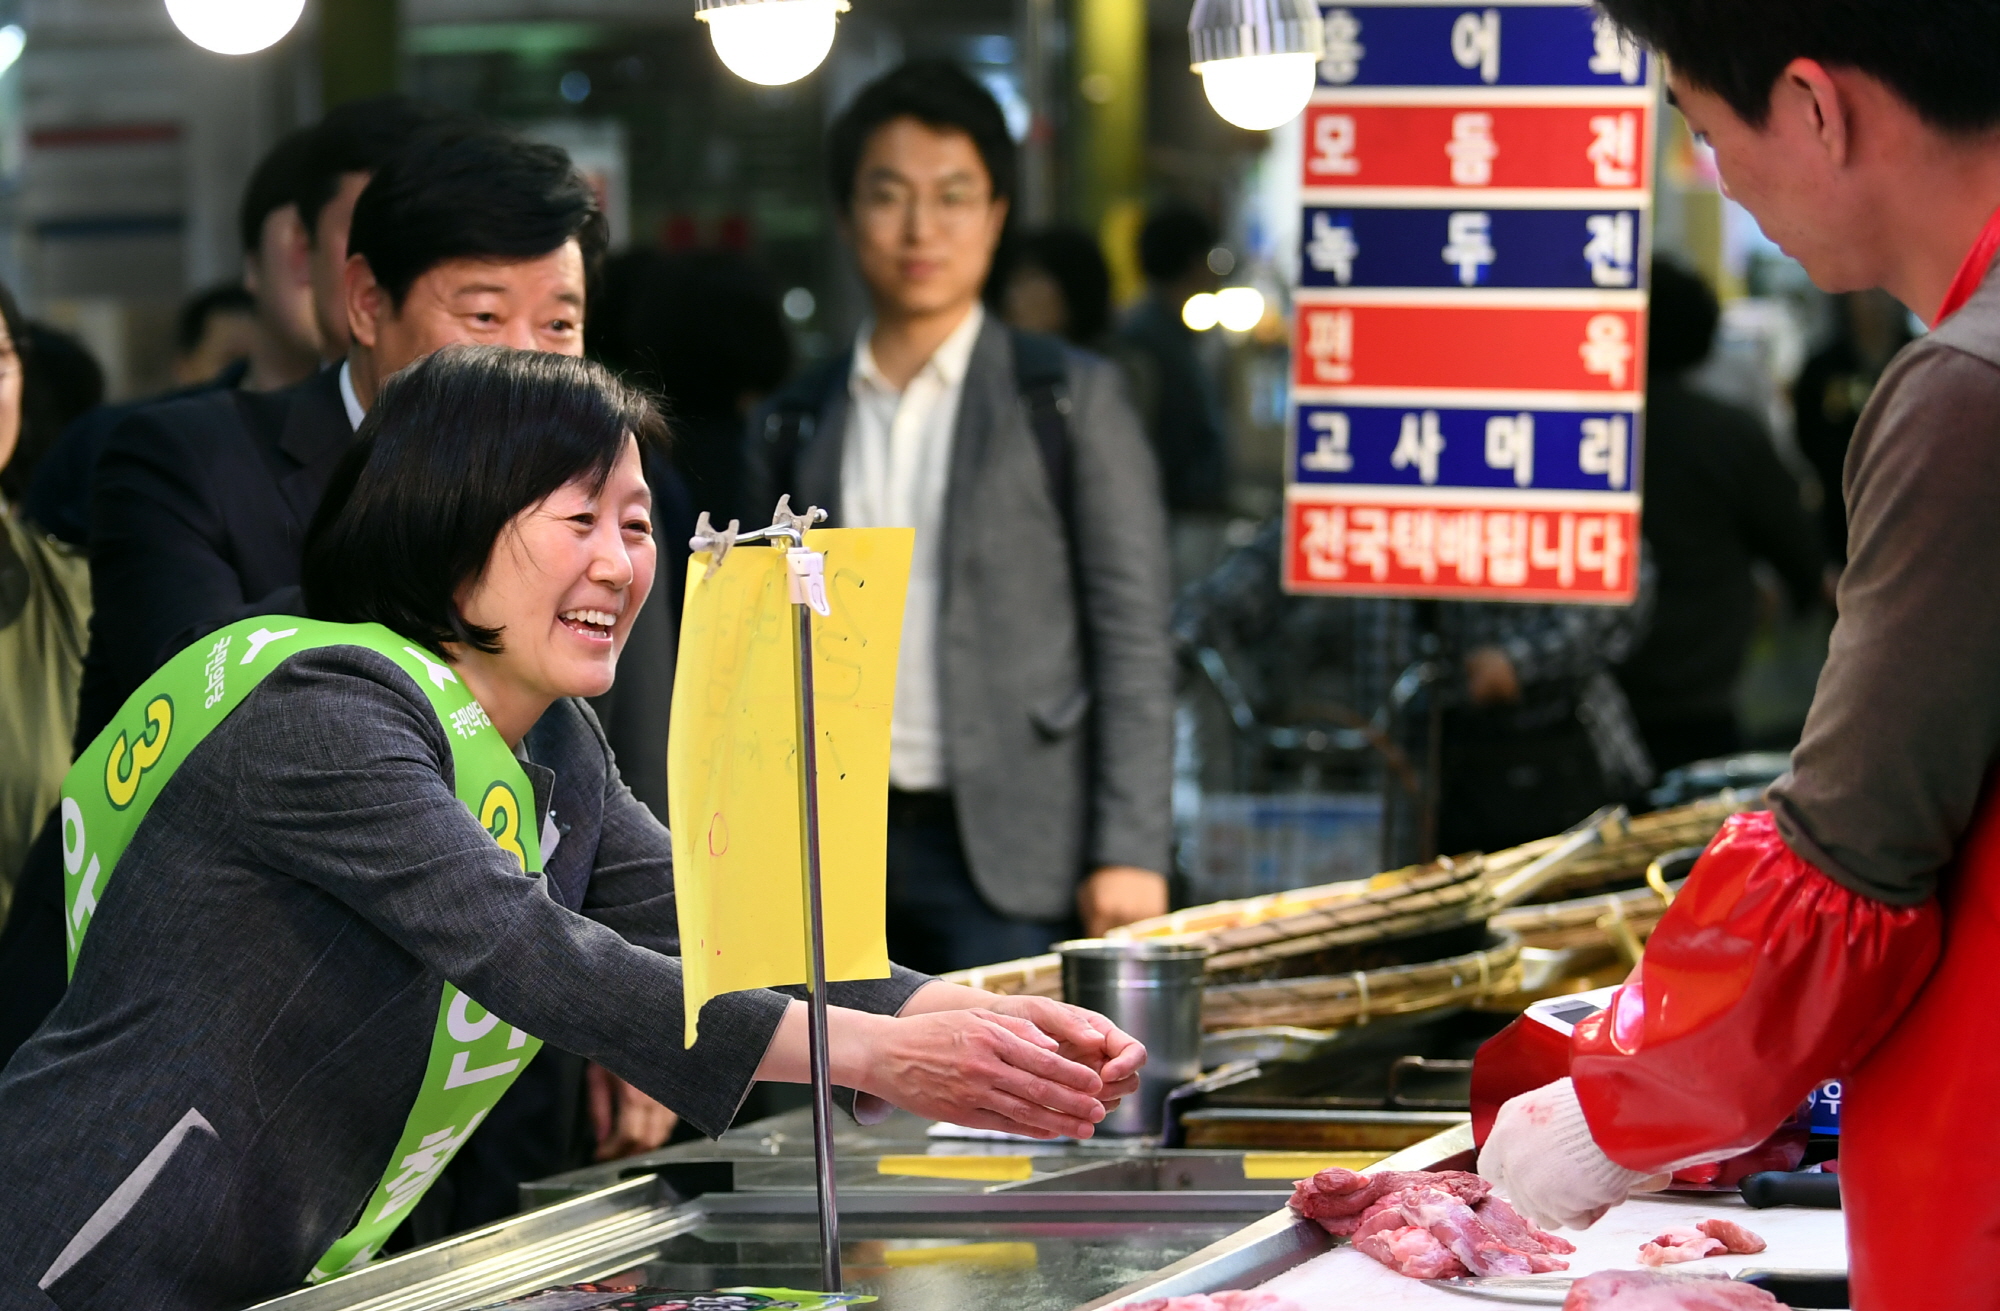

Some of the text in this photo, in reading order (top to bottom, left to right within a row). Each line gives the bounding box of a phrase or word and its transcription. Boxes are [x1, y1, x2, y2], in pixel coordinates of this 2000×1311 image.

[1307, 112, 1637, 186] 모듬전
[1306, 211, 1635, 287] 녹두전
[1301, 506, 1626, 590] 전국택배됩니다
[204, 635, 232, 709] 국민의당
[104, 693, 174, 811] 3
[449, 700, 491, 740] 국민의당
